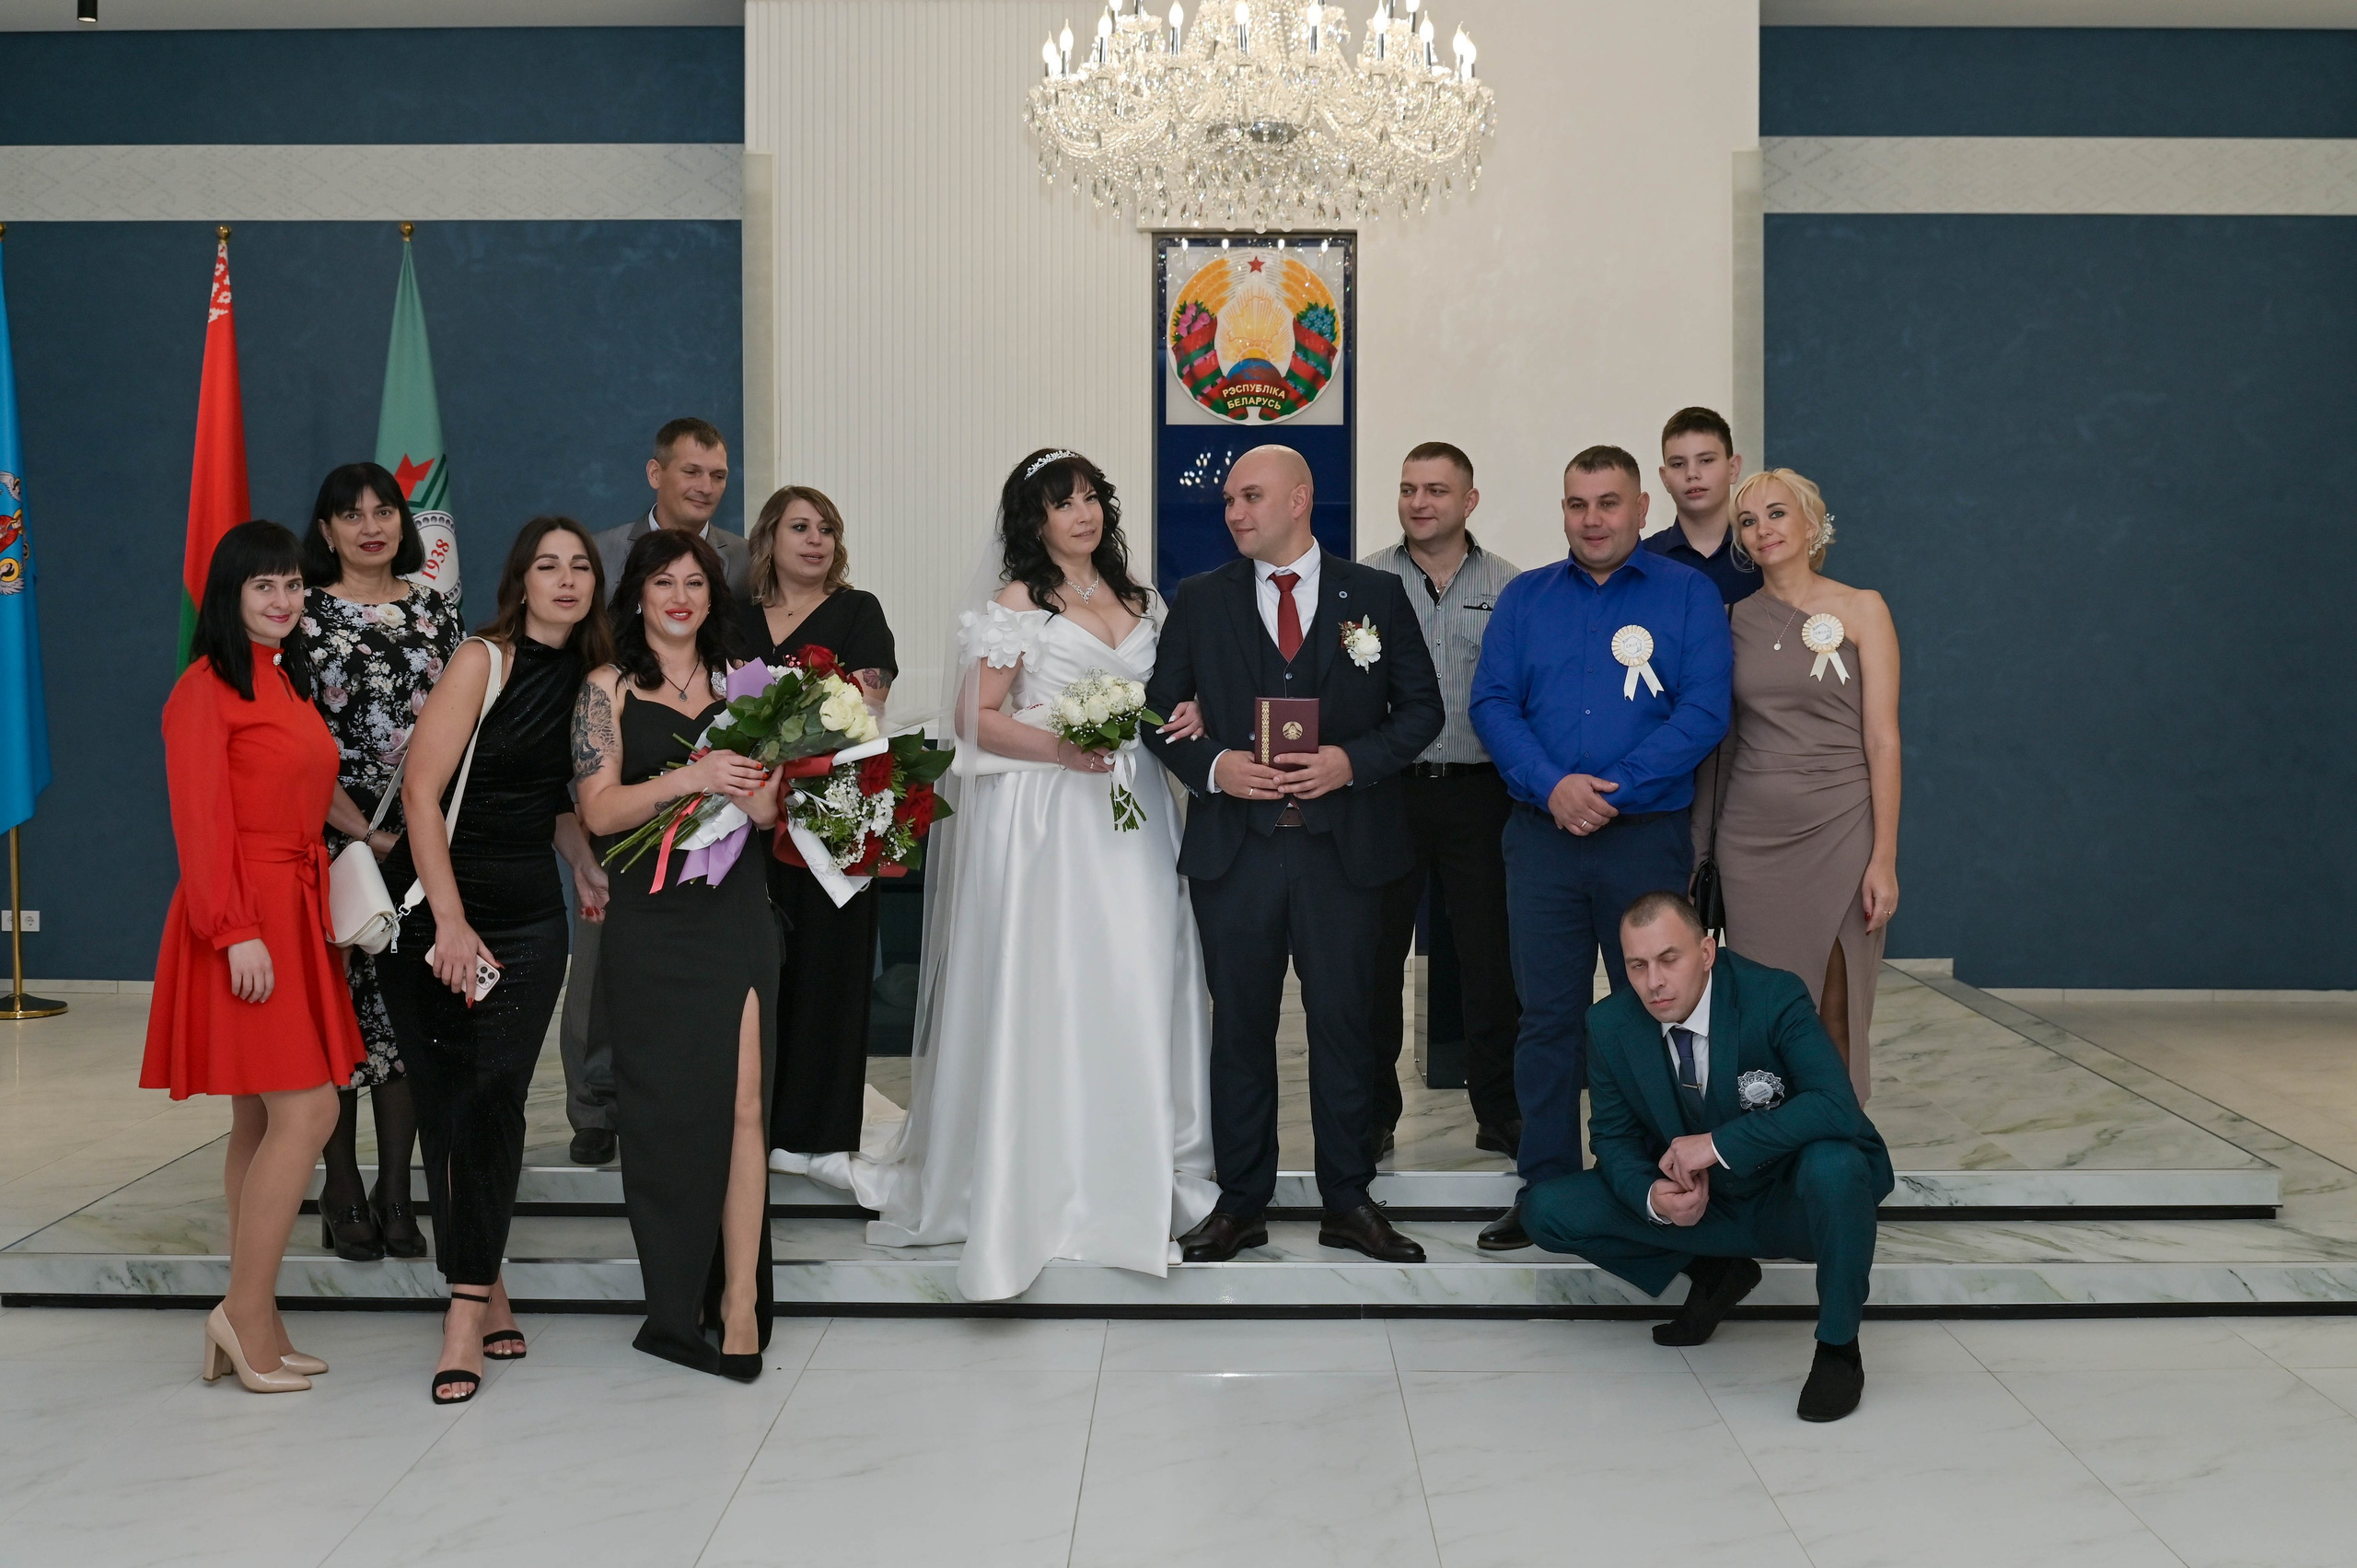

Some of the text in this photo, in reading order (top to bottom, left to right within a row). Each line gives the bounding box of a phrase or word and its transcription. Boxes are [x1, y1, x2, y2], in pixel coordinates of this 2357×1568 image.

[1222, 383, 1285, 400] РЭСПУБЛІКА
[1226, 397, 1282, 411] БЕЛАРУСЬ
[421, 538, 450, 581] 1938
